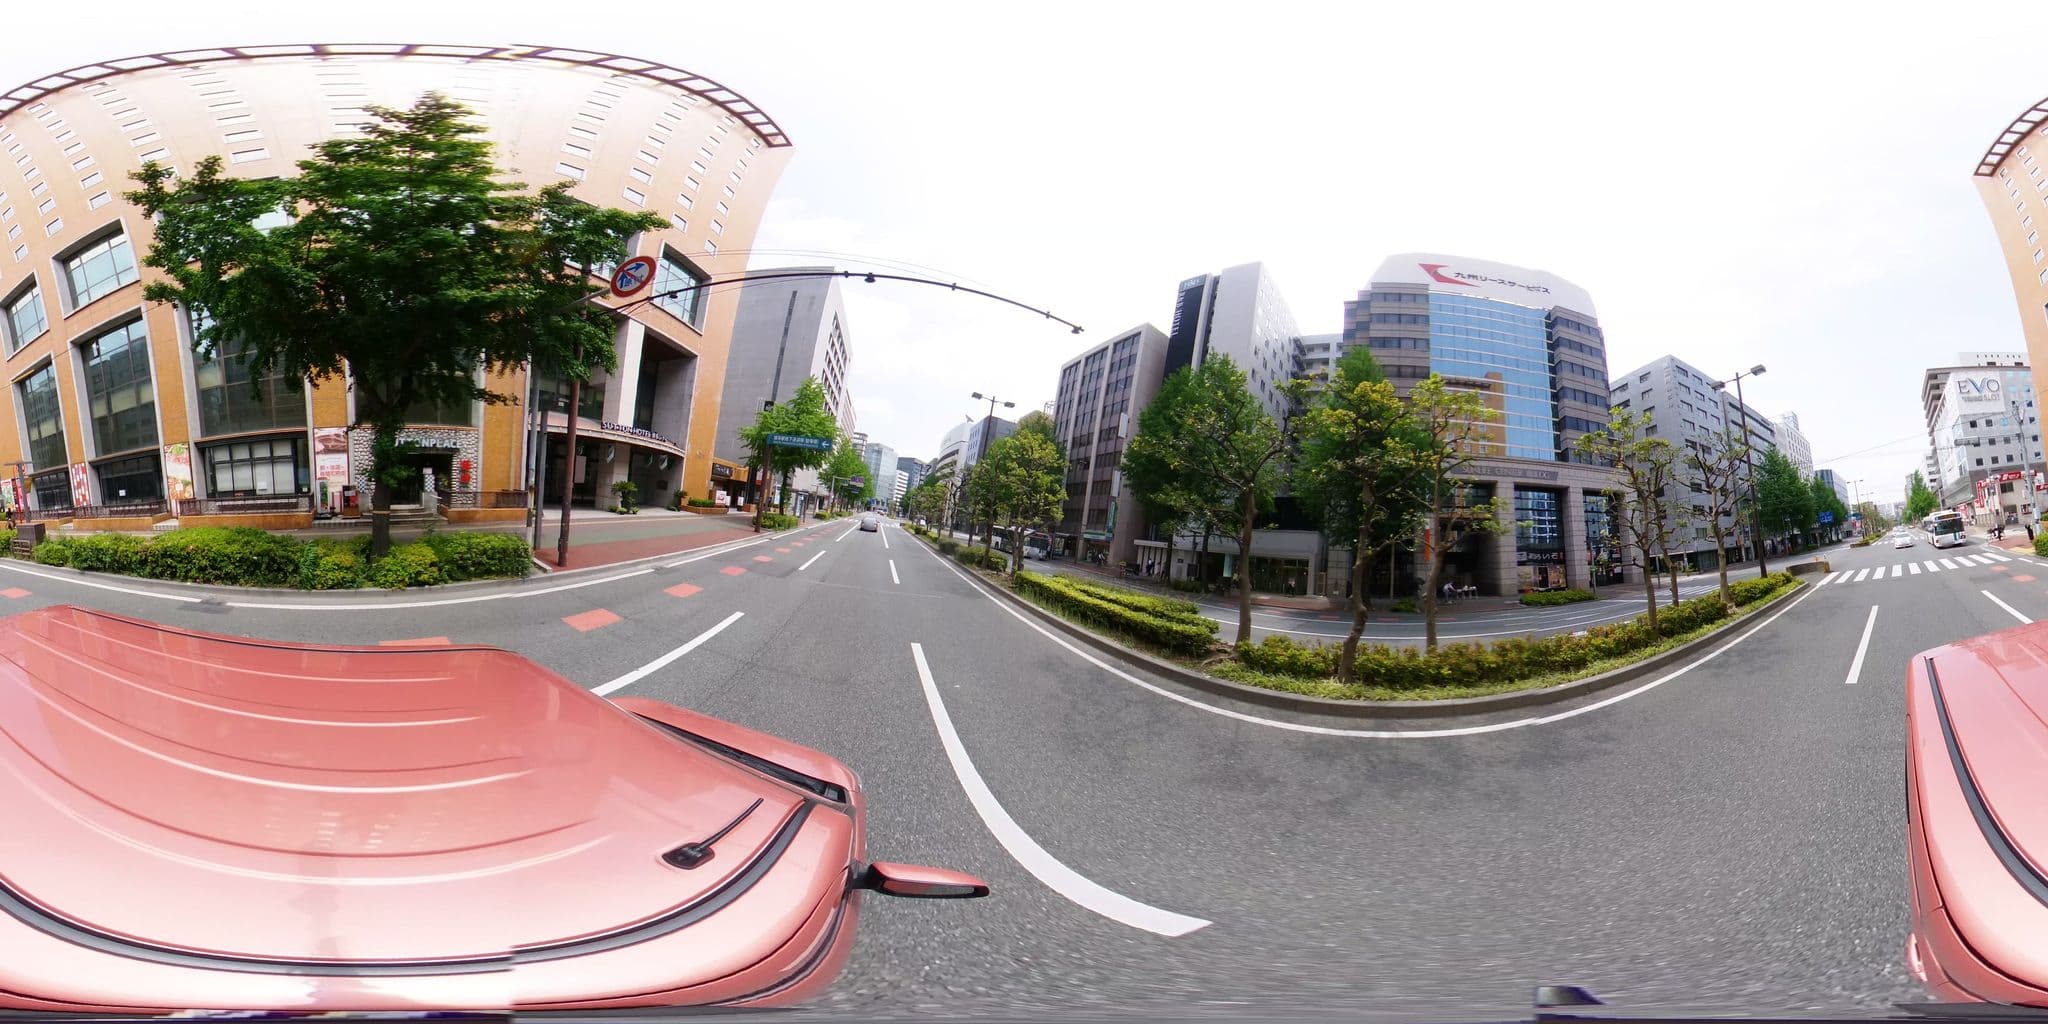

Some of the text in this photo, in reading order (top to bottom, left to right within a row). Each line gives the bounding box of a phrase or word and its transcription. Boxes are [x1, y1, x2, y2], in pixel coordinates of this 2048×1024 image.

[1454, 272, 1551, 294] 九州リースサービス
[1955, 377, 2000, 394] EVO
